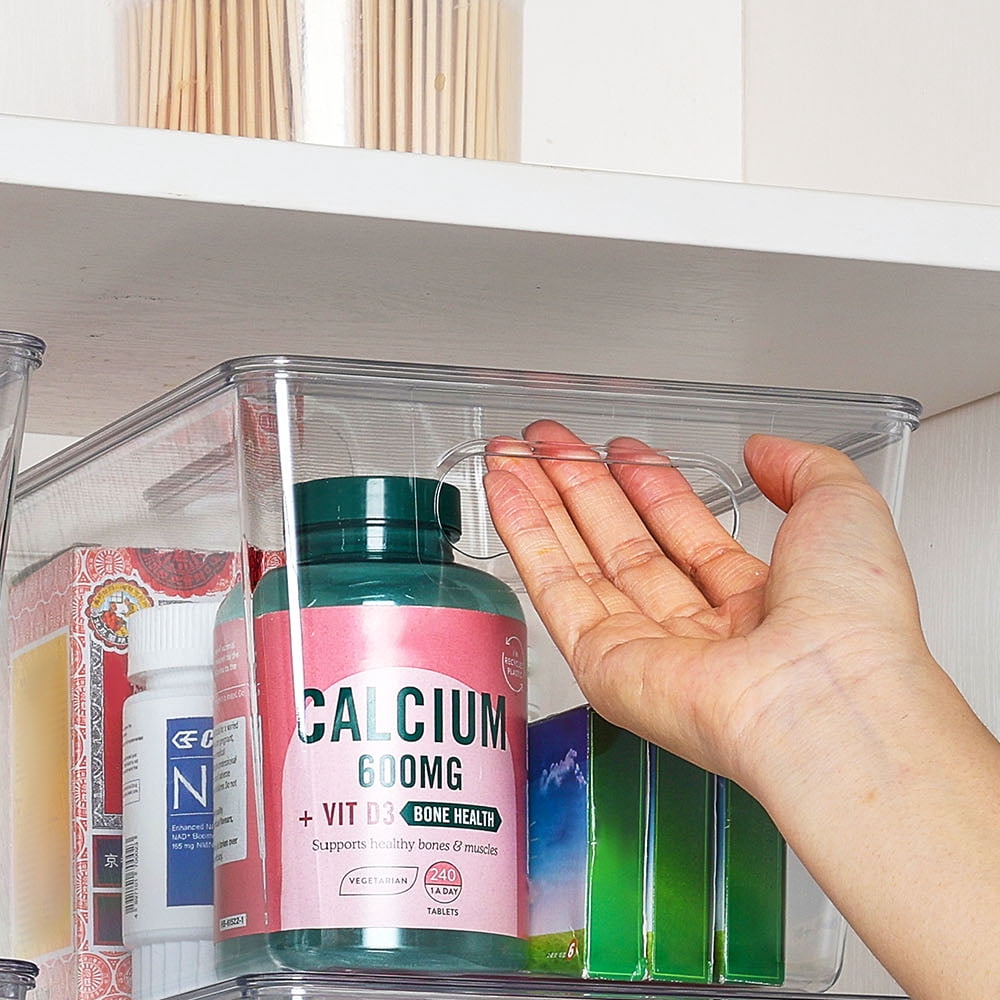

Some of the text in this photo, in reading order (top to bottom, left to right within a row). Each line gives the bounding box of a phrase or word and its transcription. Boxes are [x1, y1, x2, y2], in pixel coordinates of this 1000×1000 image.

[297, 686, 506, 751] CALCIUM
[358, 754, 463, 791] 600MG
[322, 802, 358, 826] VIT
[366, 801, 395, 826] D3
[413, 805, 450, 824] BONE
[454, 808, 495, 828] HEALTH
[312, 837, 499, 857] Supports healthy bones & muscles
[104, 853, 119, 869] 京
[348, 877, 408, 885] VEGETARIAN
[430, 867, 456, 883] 240
[442, 887, 458, 897] DAY
[426, 907, 459, 917] TABLETS
